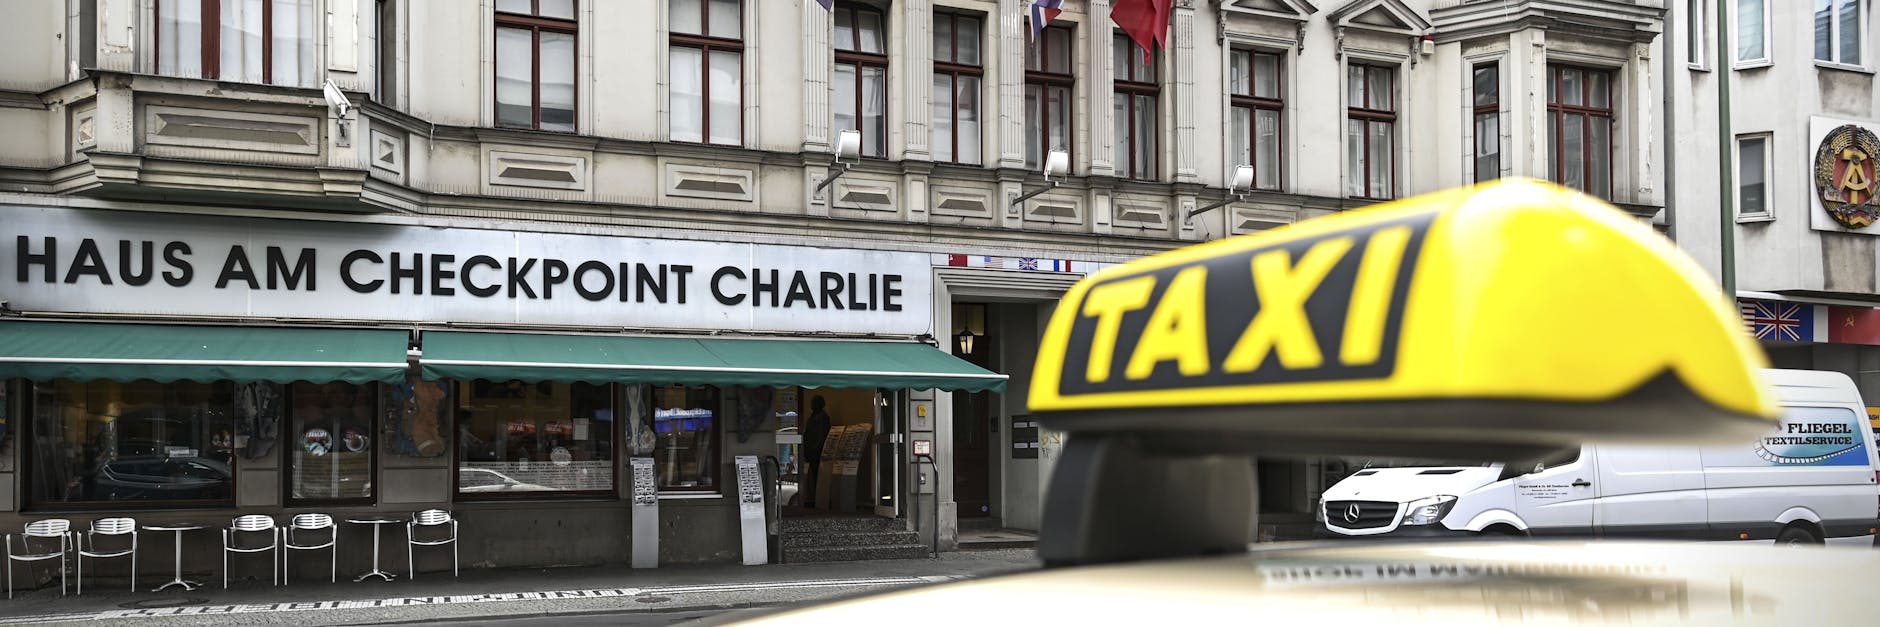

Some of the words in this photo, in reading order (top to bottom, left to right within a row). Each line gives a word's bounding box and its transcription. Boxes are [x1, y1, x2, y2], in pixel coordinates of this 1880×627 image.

[16, 235, 195, 288] HAUS
[215, 244, 317, 291] AM
[340, 249, 693, 304] CHECKPOINT
[710, 266, 902, 312] CHARLIE
[1083, 226, 1412, 383] TAXI
[1765, 436, 1852, 445] TEXTILSERVICE
[1787, 423, 1852, 434] FLIEGEL
